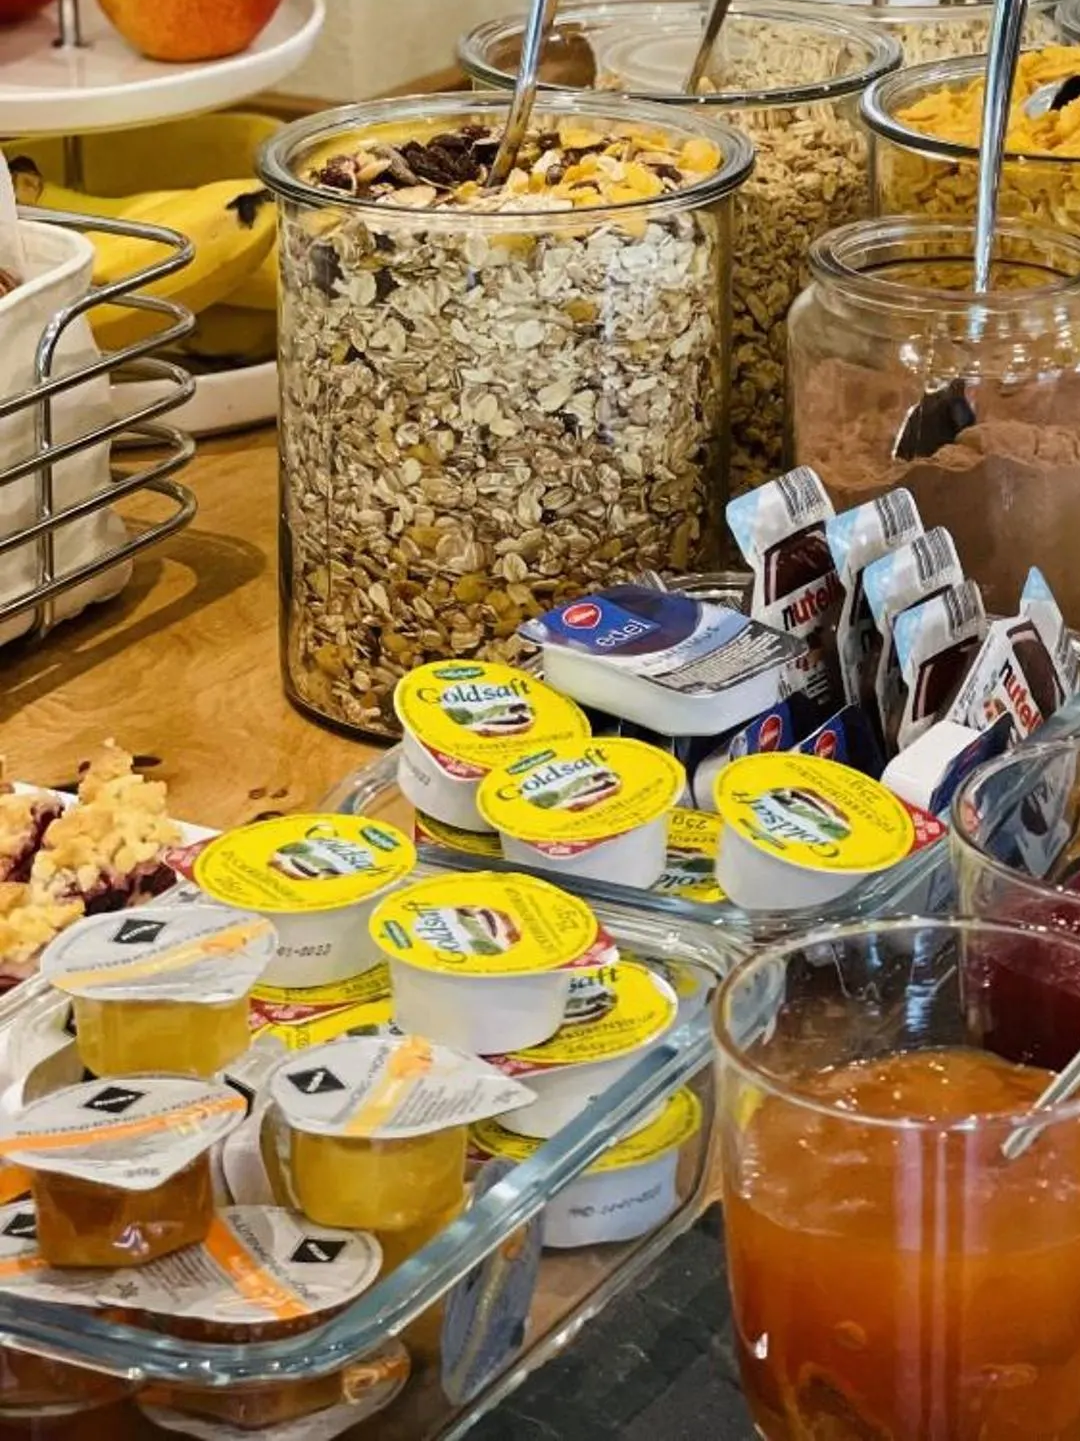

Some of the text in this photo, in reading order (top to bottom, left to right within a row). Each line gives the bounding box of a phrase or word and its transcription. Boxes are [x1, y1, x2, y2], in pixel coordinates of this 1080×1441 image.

[782, 568, 843, 631] nutell
[596, 618, 652, 648] edel
[416, 677, 532, 705] Goldsaft
[496, 746, 609, 801] Goldsaft
[731, 790, 840, 858] Goldsaft
[401, 900, 468, 964] Goldsaft
[567, 966, 617, 993] saft
